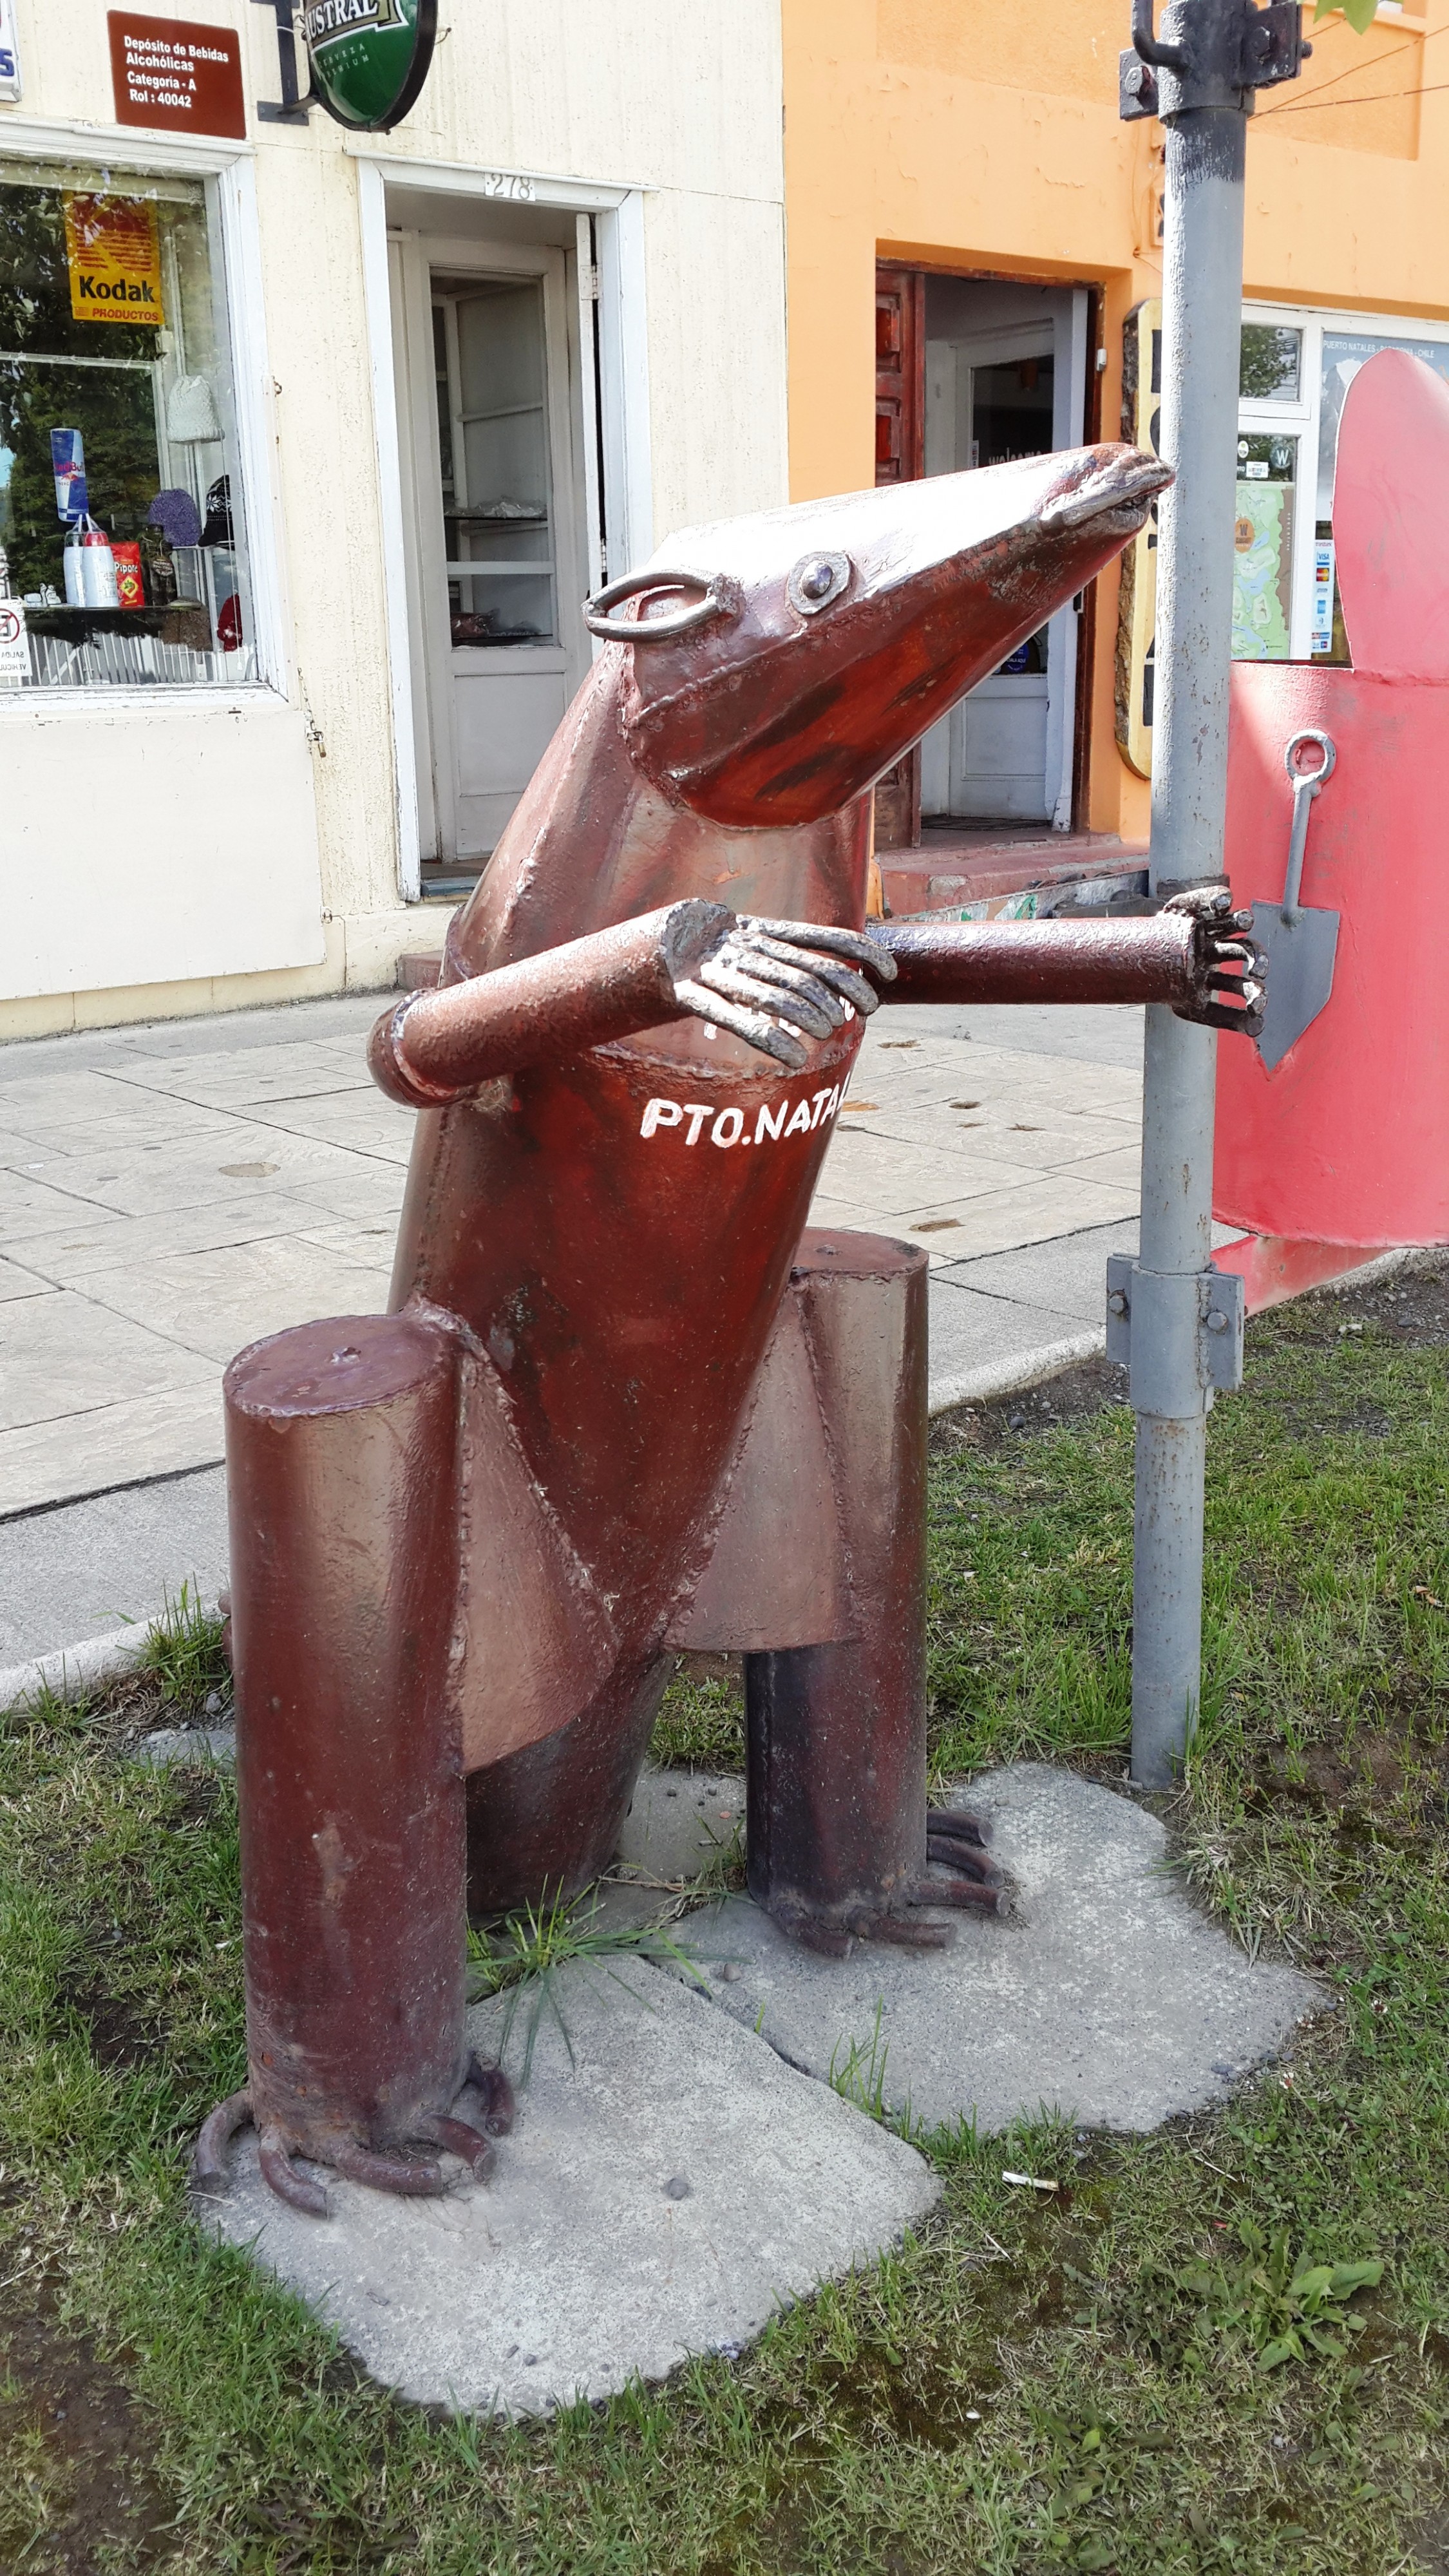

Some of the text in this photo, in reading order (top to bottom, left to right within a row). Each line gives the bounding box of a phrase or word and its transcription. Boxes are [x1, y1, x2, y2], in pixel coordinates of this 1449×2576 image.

[124, 35, 229, 62] Depósito de Bebidas
[126, 52, 194, 71] Alcohólicas
[189, 79, 196, 91] A
[129, 89, 148, 102] Rol
[157, 92, 192, 108] 40042
[491, 173, 530, 200] 278
[79, 275, 156, 303] Kodak
[92, 308, 158, 321] PRODUCTOS
[1323, 340, 1347, 350] PUERTO
[1349, 343, 1376, 353] NATALES
[1418, 349, 1435, 358] CHILE
